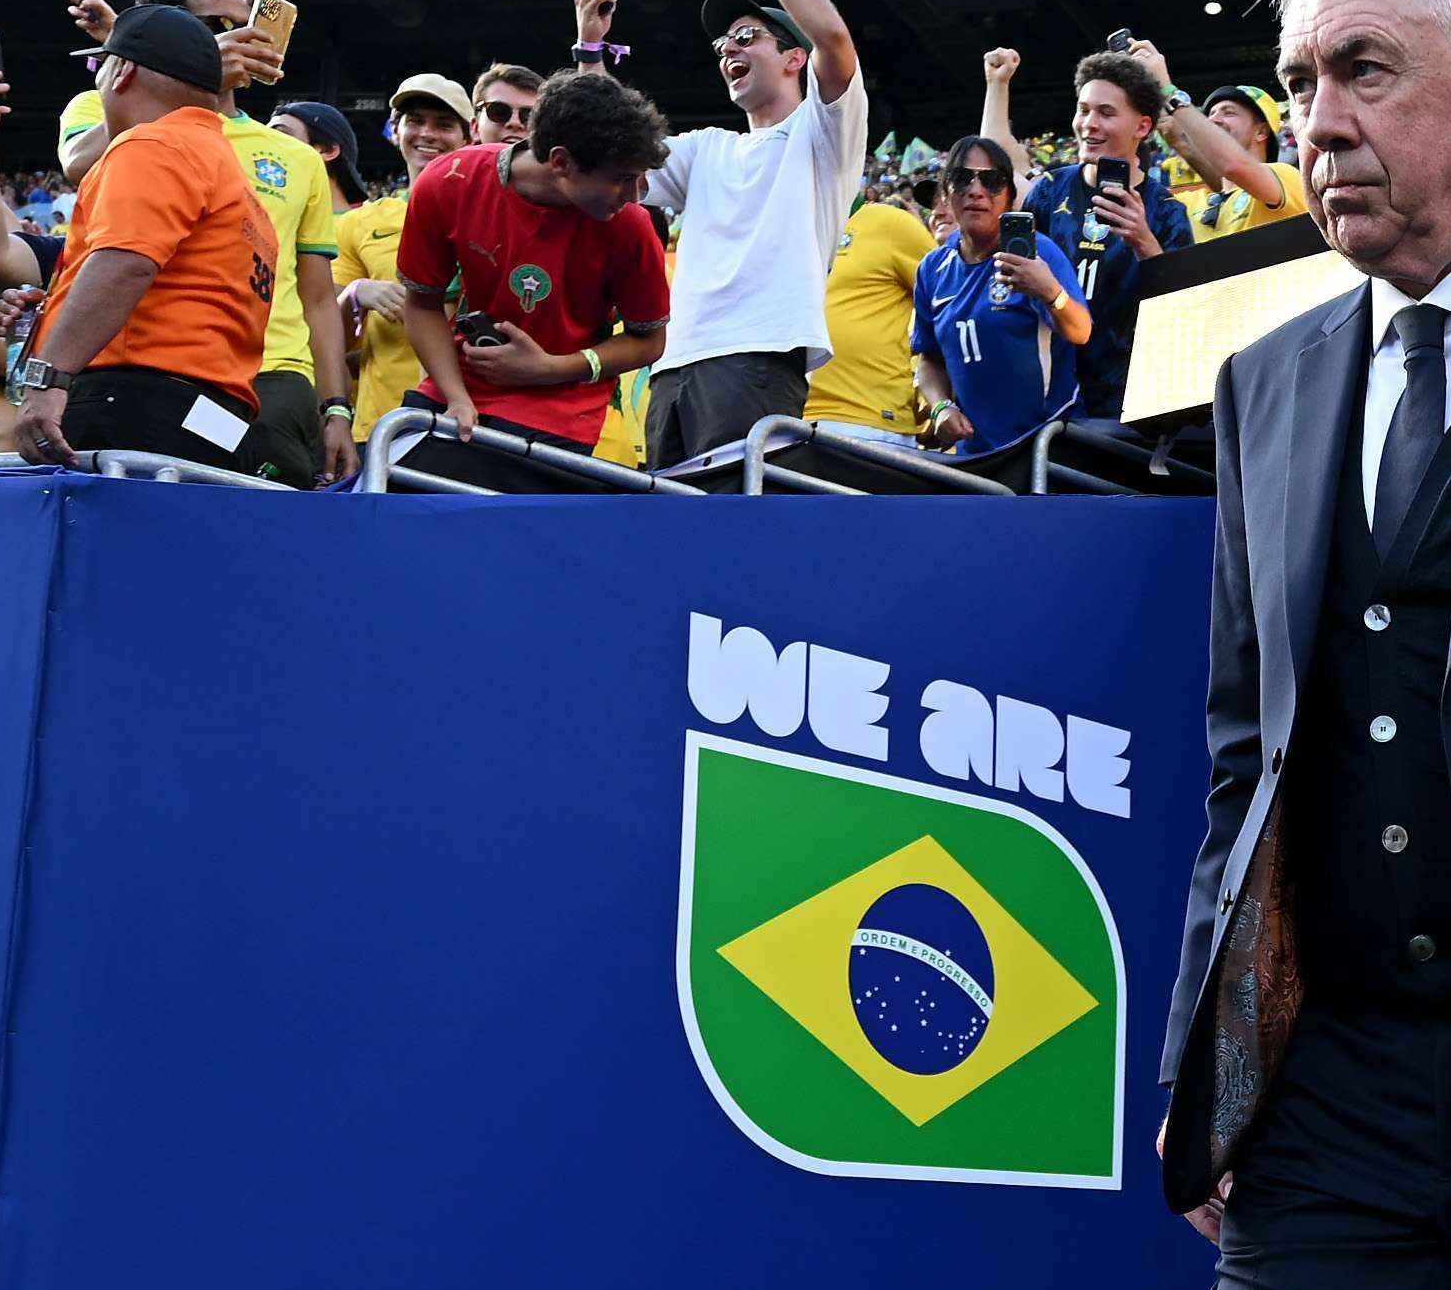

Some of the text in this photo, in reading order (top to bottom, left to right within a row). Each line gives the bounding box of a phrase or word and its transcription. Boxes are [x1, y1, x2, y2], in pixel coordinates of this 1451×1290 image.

[249, 251, 276, 303] 38
[1076, 258, 1099, 300] 11
[955, 318, 983, 364] 11
[687, 611, 891, 763] WE
[860, 931, 989, 1008] ORDEM E PROGRESSO
